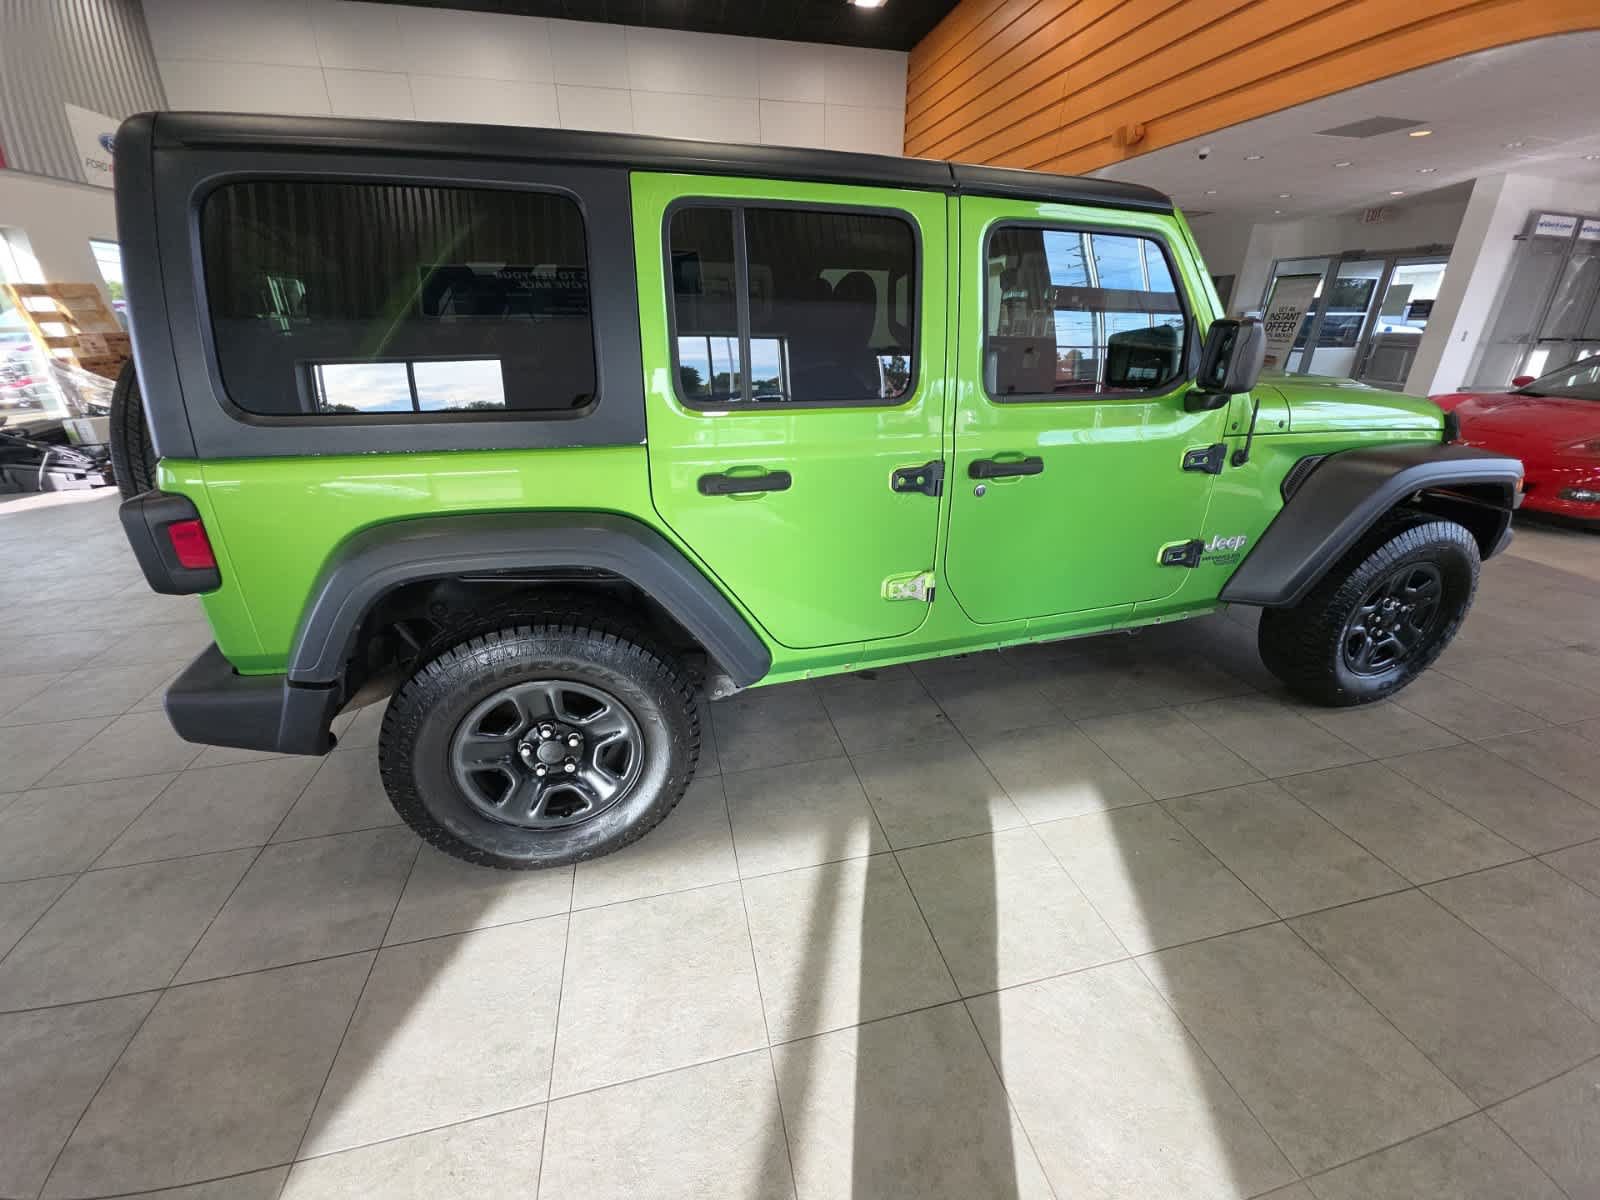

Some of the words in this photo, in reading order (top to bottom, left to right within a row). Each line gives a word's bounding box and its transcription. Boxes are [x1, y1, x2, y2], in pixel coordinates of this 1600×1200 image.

[86, 158, 107, 171] FORD
[1269, 311, 1302, 321] INSTANT
[1264, 321, 1298, 332] OFFER
[1204, 535, 1247, 552] Jeep
